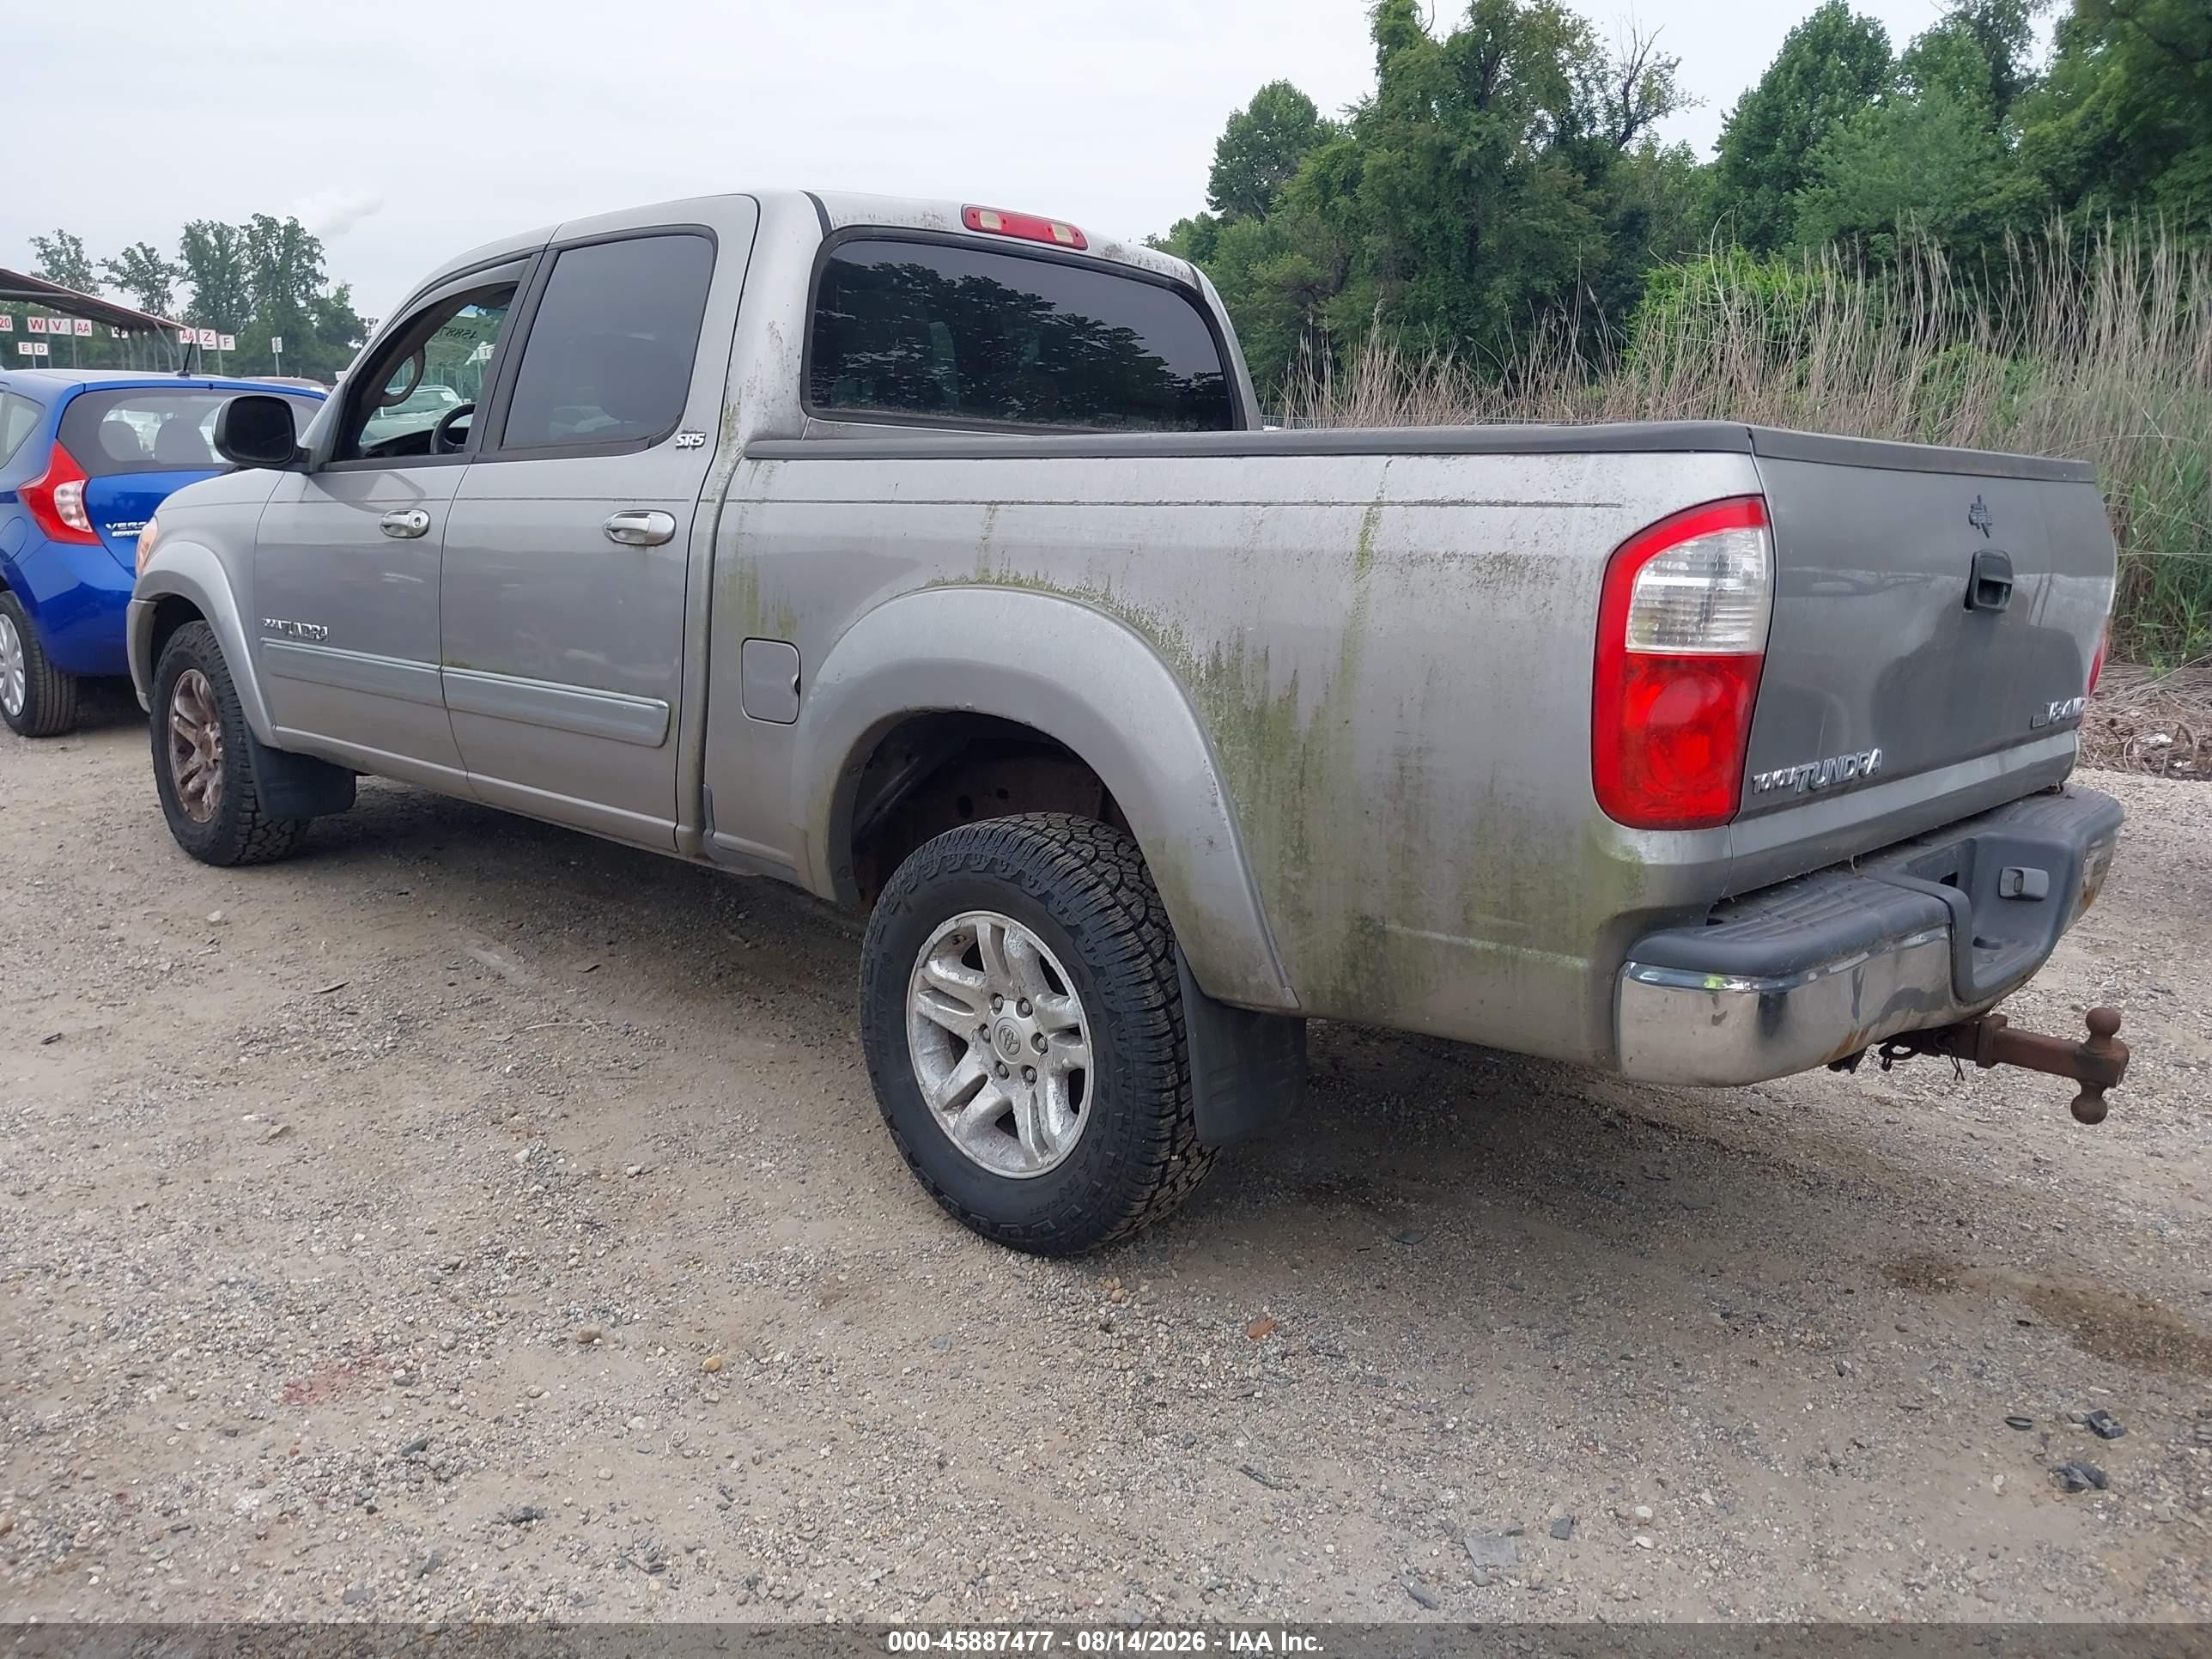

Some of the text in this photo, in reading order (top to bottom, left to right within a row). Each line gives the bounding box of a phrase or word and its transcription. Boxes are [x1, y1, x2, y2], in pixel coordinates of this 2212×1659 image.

[29, 319, 44, 331] W
[52, 321, 62, 331] V
[76, 322, 90, 333] AA
[182, 330, 193, 340] AA
[204, 331, 213, 342] Z
[223, 337, 230, 348] F
[37, 345, 45, 354] D
[1794, 748, 1882, 793] TUNDRA
